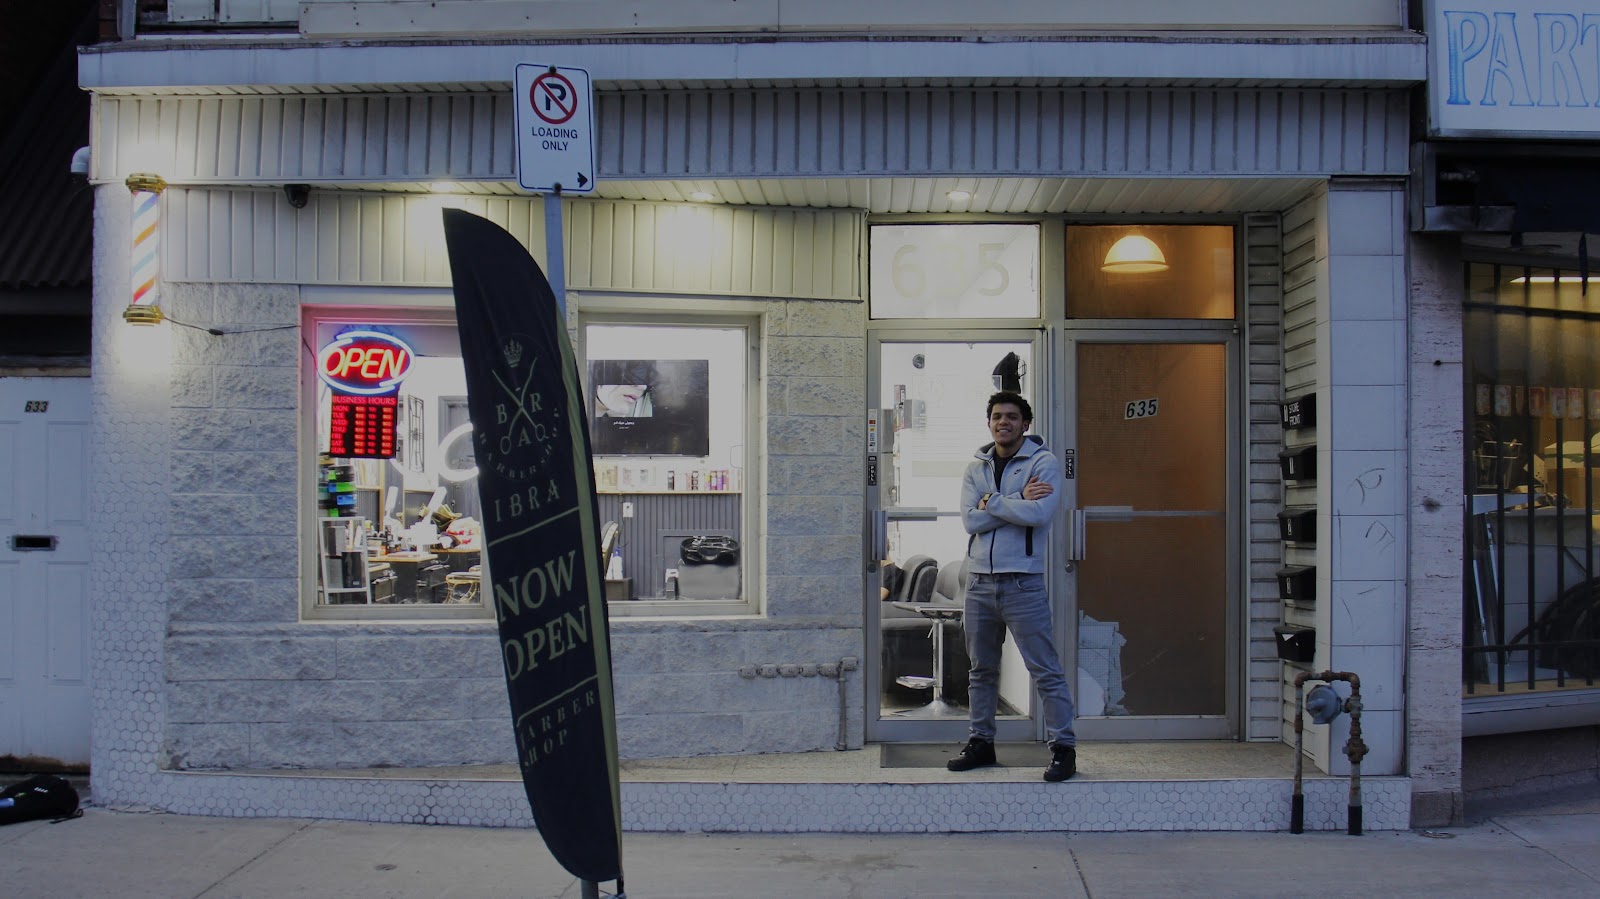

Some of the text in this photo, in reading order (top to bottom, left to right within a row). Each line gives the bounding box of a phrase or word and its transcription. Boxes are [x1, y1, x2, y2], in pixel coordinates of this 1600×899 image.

[532, 126, 578, 139] LOADING
[541, 140, 569, 151] ONLY
[324, 347, 406, 379] OPEN
[24, 400, 49, 413] 633
[332, 396, 395, 405] BUSINESS HOURS
[1126, 398, 1157, 419] 635
[494, 479, 560, 523] IBRA
[494, 549, 576, 625] NOW
[504, 604, 589, 681] OPEN
